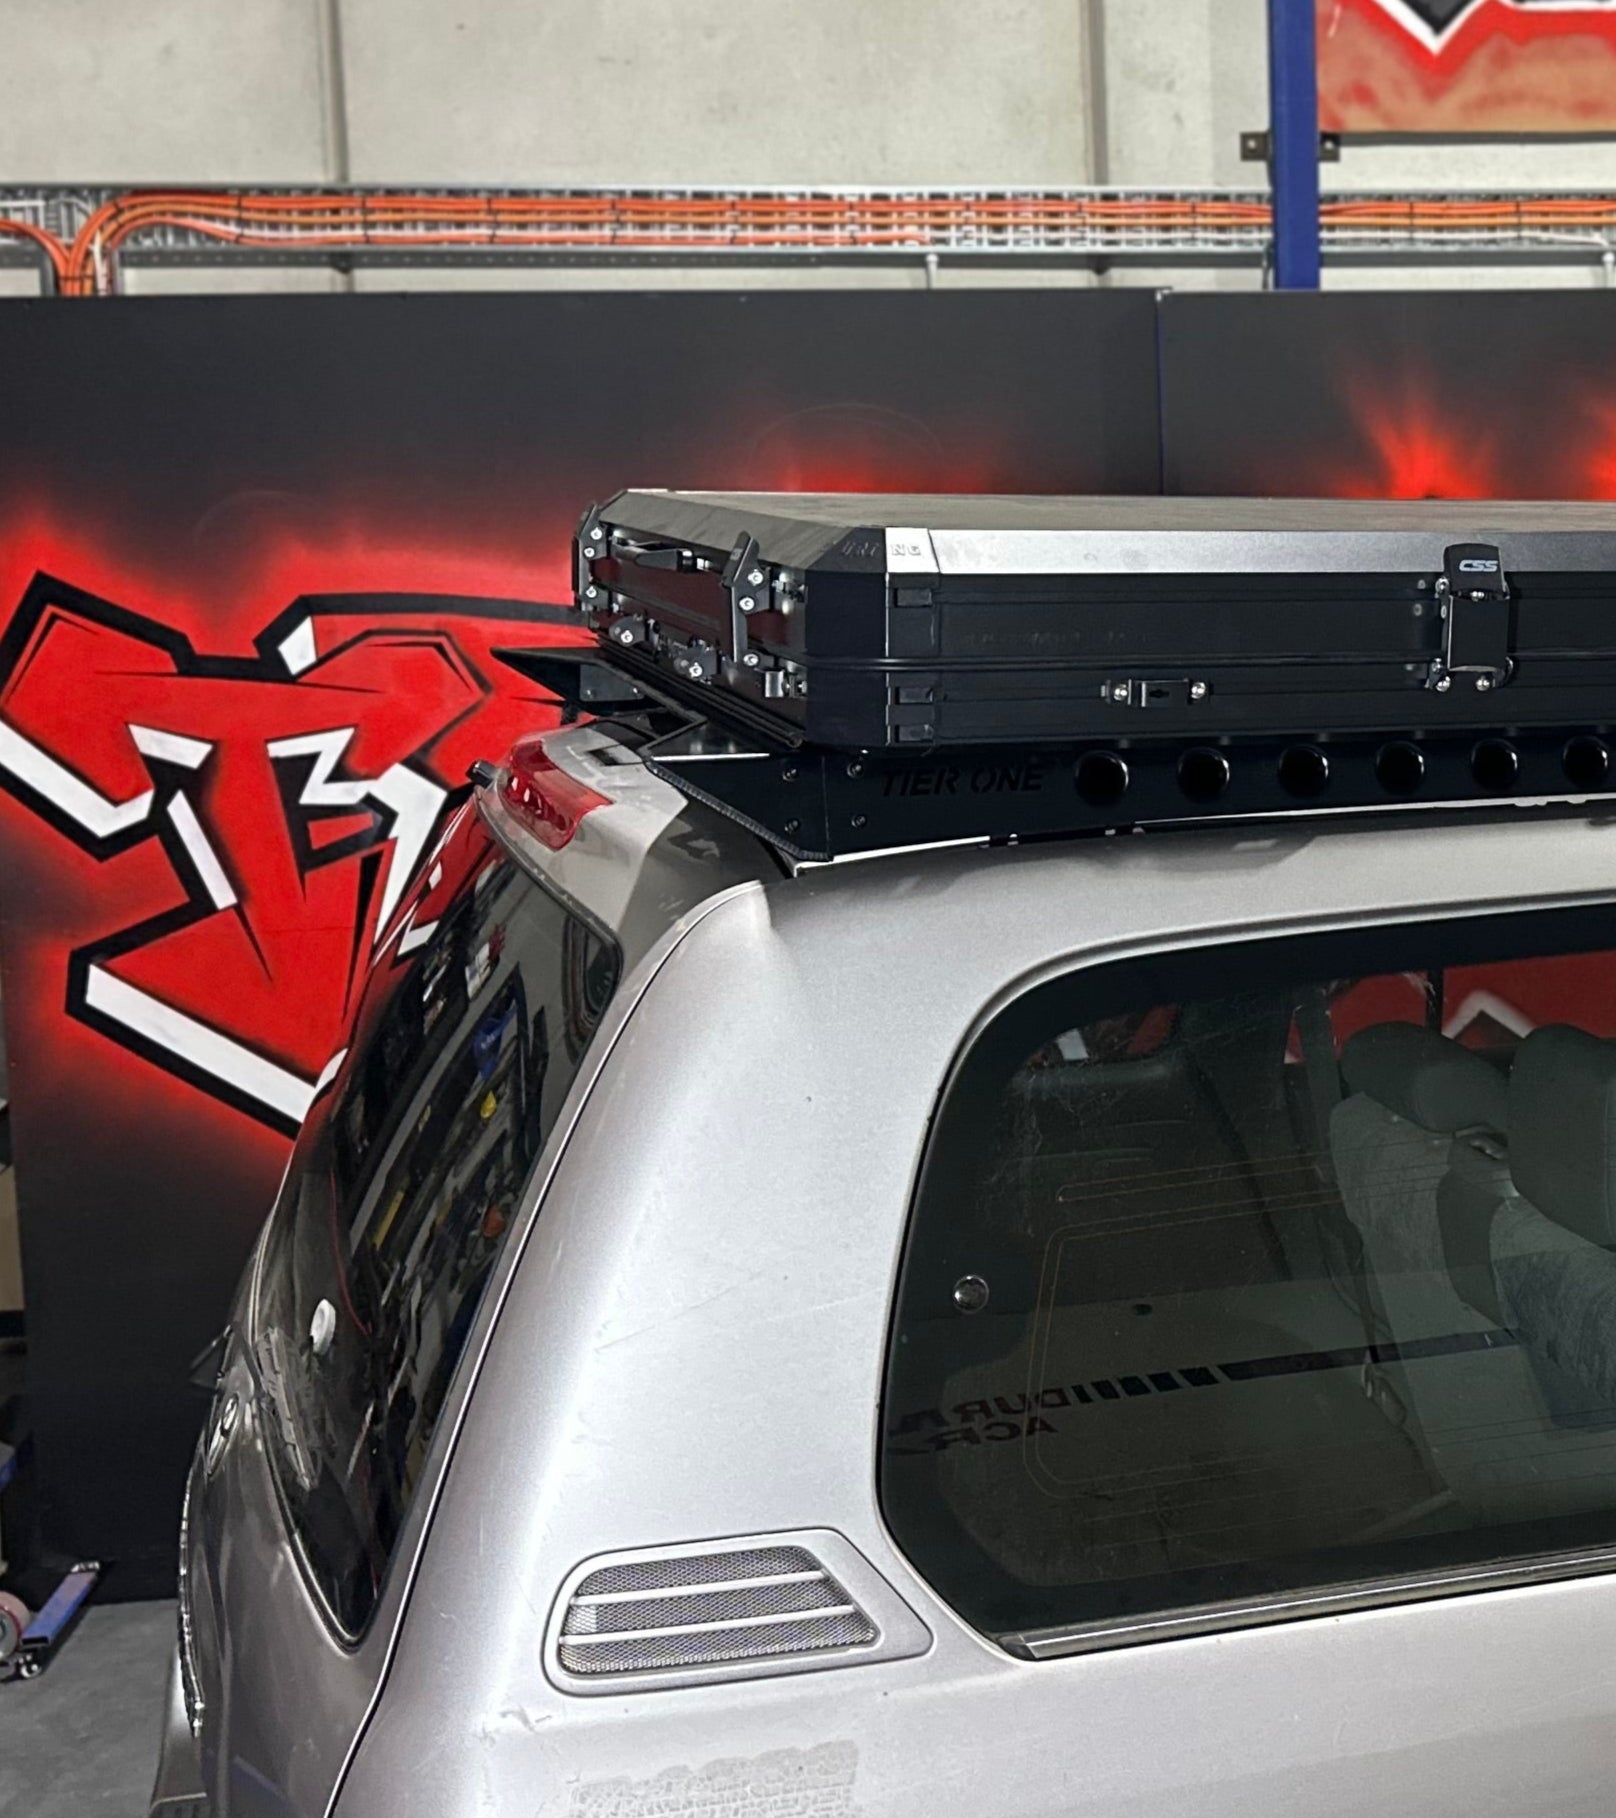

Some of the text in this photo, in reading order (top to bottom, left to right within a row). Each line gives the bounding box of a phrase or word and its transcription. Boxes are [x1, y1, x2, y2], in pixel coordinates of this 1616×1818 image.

[1459, 560, 1498, 571] CSS
[882, 764, 1043, 797] TIER ONE
